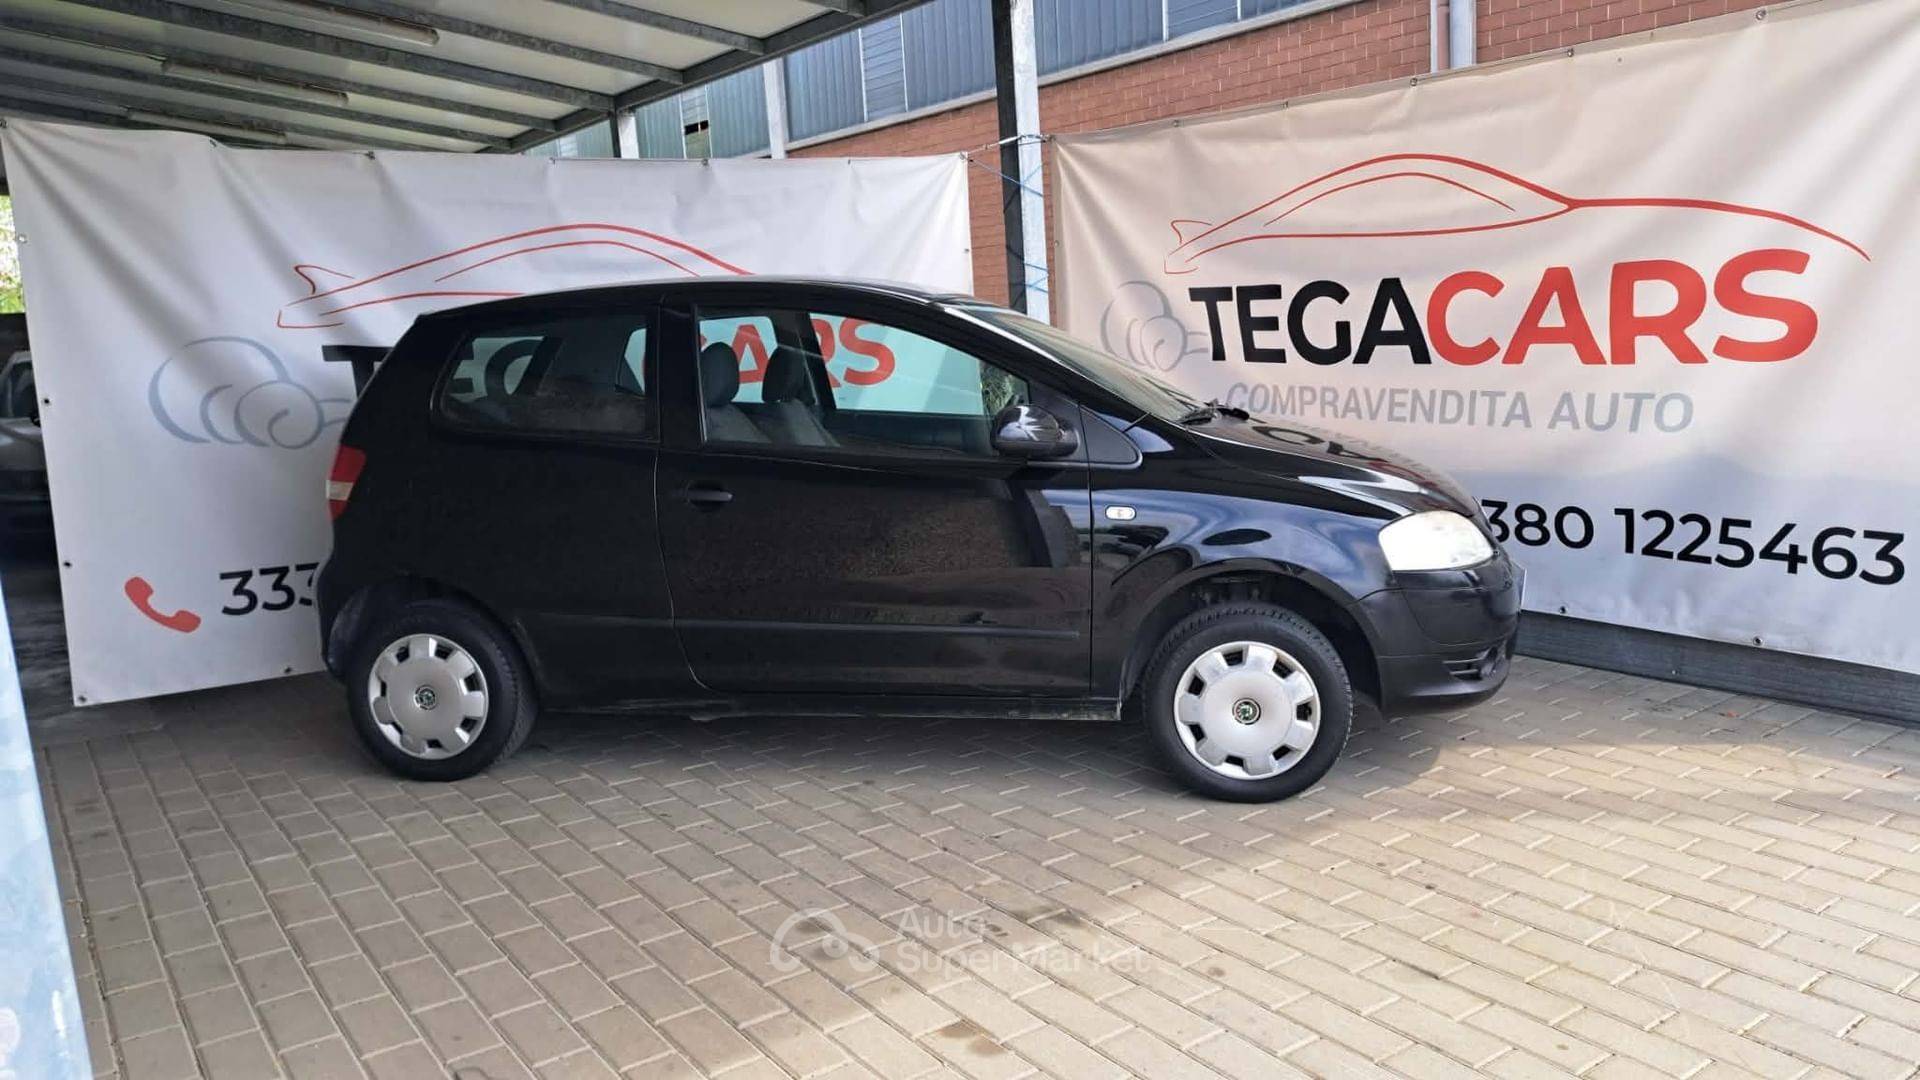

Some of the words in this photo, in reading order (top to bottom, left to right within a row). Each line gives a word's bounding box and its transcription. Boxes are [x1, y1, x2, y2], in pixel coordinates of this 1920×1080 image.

[1188, 249, 1819, 366] TEGACARS
[1226, 382, 1532, 429] COMPRAVENDITA
[1547, 389, 1694, 434] AUTO
[1481, 498, 1595, 550] 380
[1613, 507, 1906, 586] 1225463
